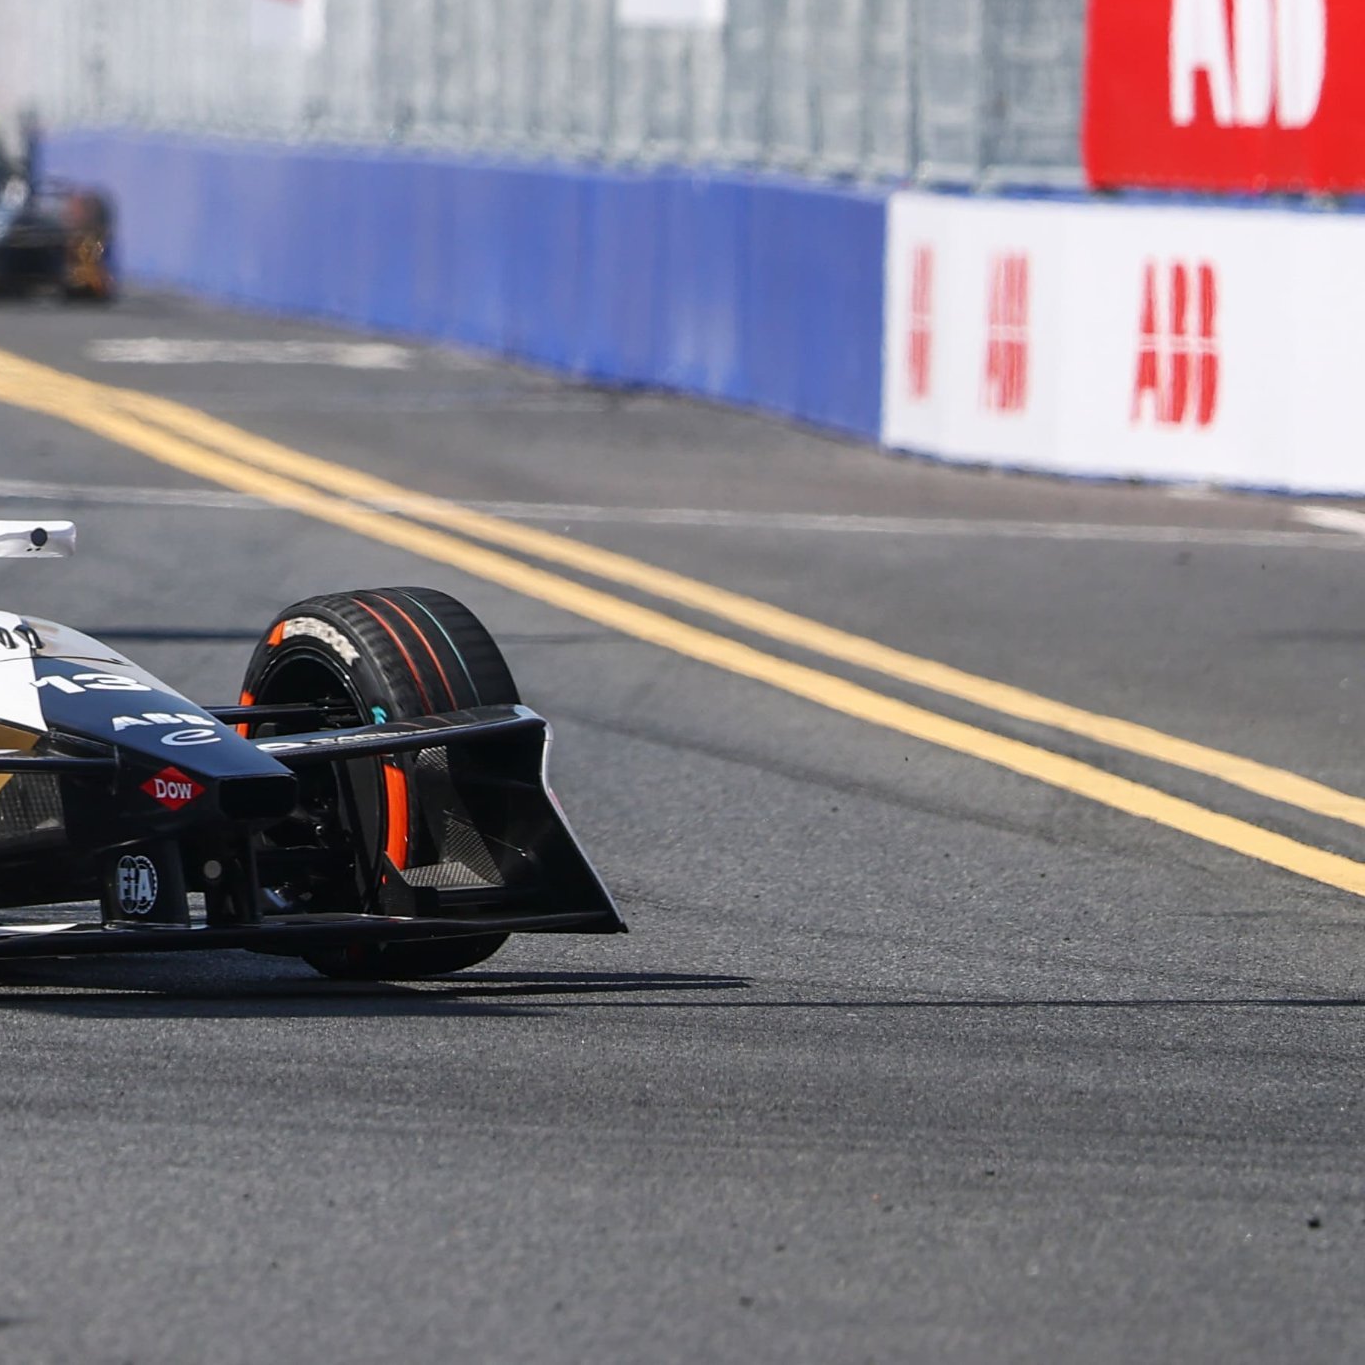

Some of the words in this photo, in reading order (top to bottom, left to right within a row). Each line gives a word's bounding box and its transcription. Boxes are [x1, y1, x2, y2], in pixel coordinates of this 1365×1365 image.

[1131, 256, 1219, 428] ABB
[30, 673, 152, 694] 13
[112, 712, 216, 731] ABB
[117, 867, 154, 900] FIA
